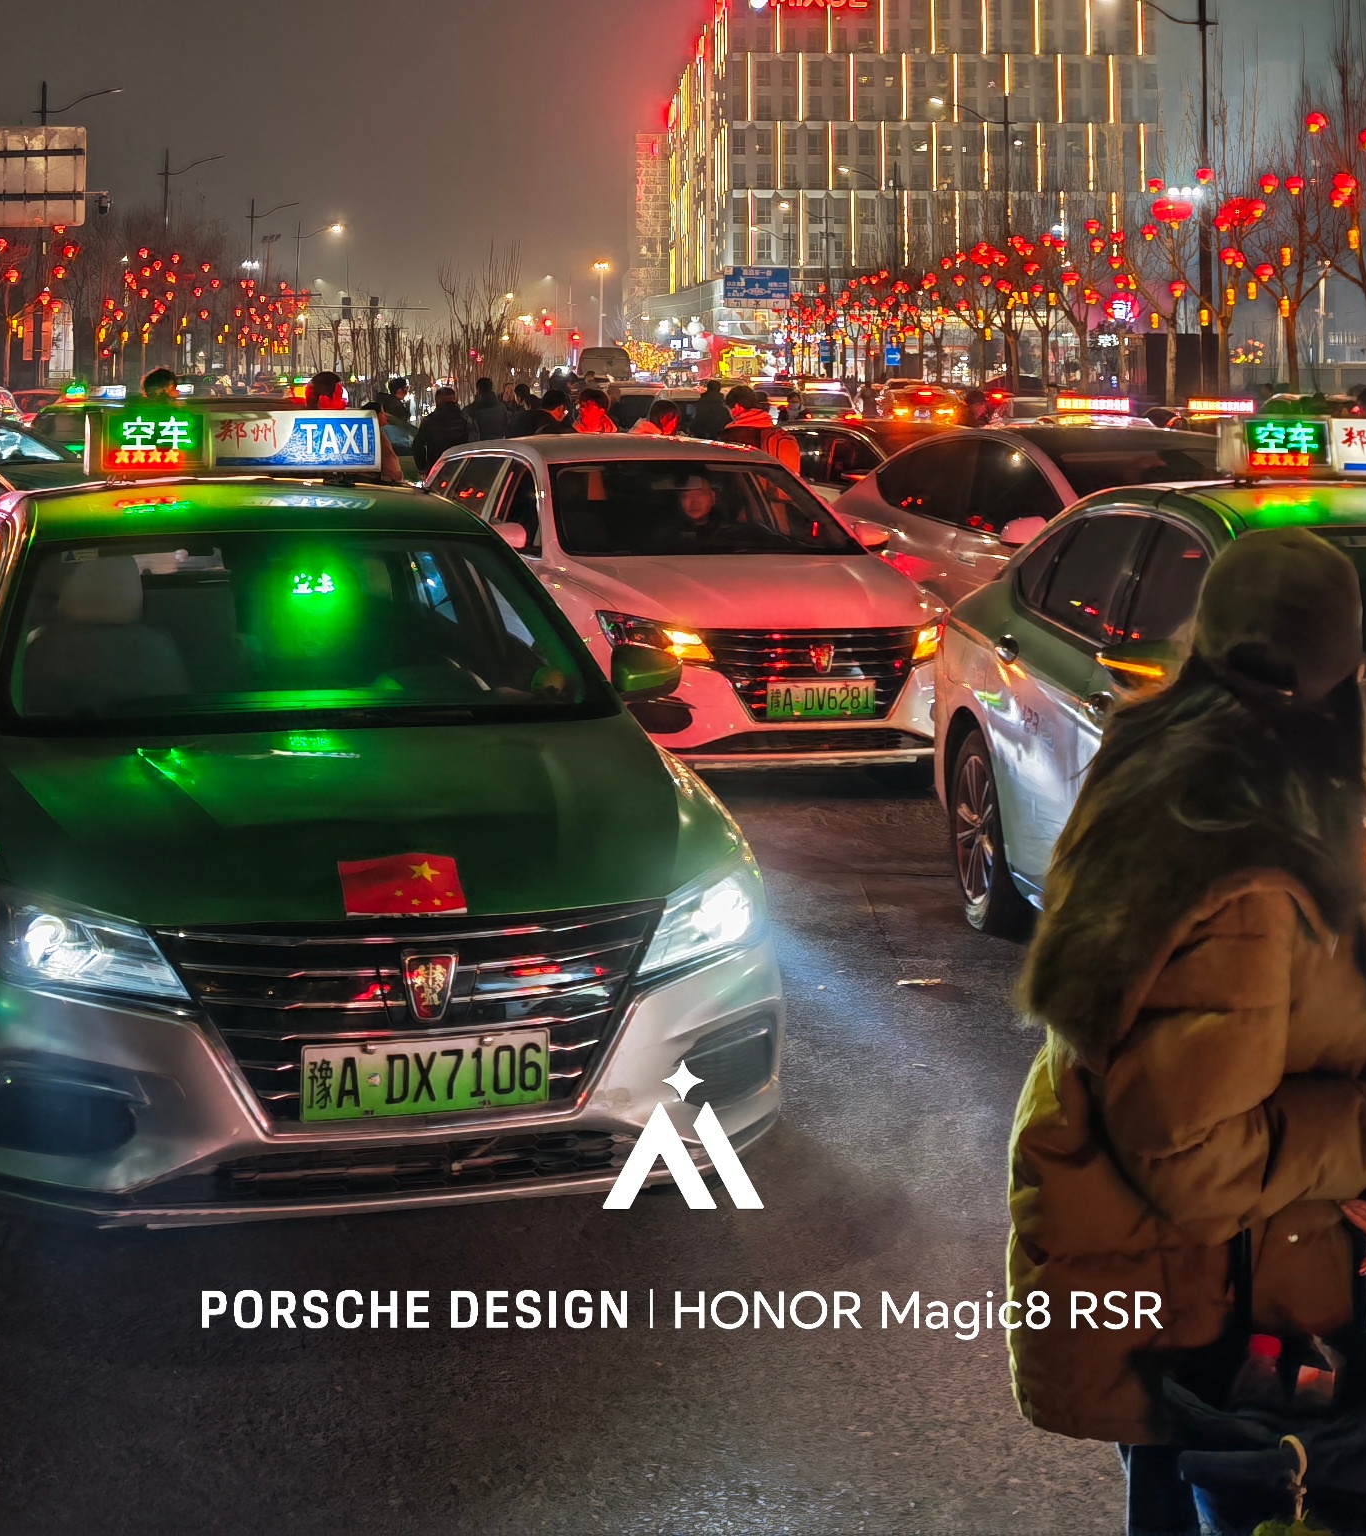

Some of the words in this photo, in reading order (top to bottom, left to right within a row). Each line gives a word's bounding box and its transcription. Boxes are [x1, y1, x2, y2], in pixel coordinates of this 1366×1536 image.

[121, 415, 192, 450] 空车
[214, 419, 277, 450] 郑州
[300, 423, 370, 455] TAXI
[1256, 422, 1319, 454] 空车
